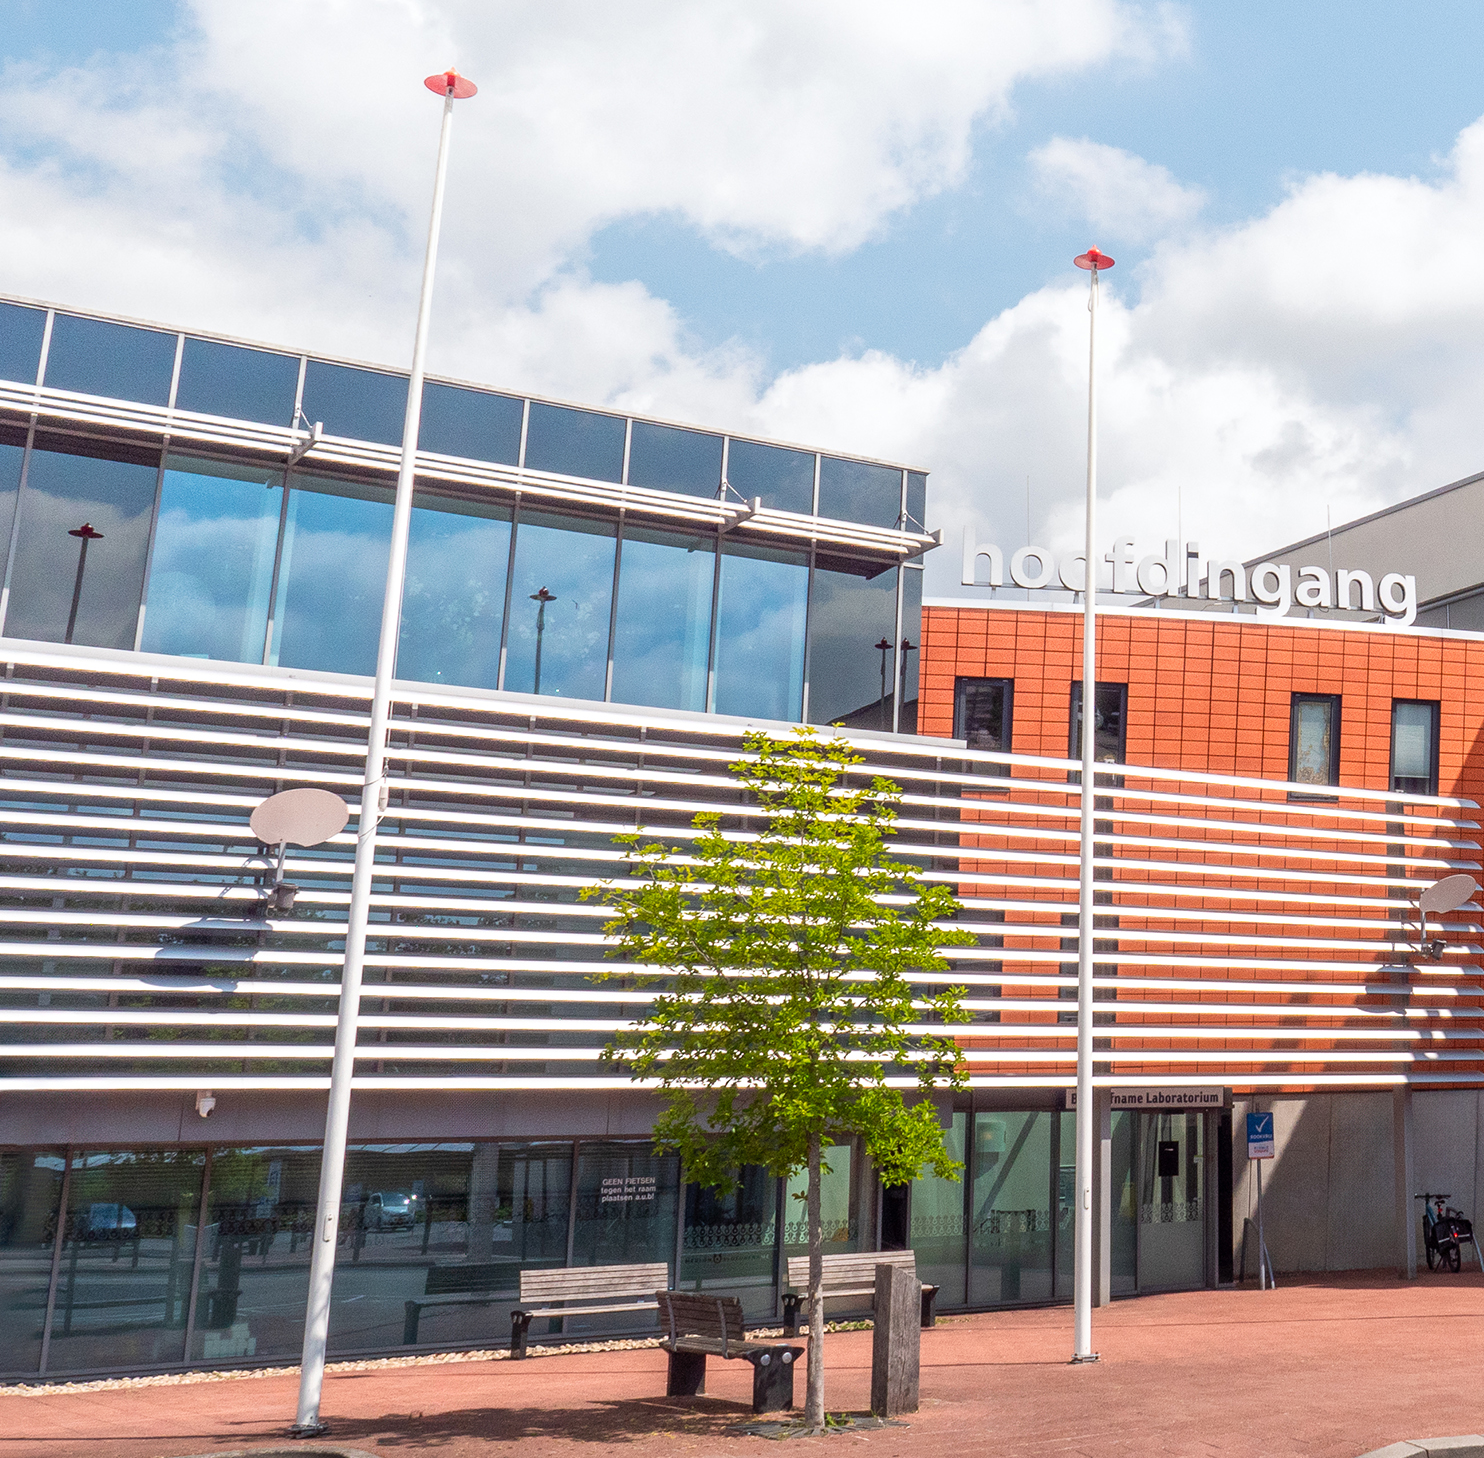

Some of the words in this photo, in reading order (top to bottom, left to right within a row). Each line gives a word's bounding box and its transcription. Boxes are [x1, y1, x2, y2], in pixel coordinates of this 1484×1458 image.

[962, 525, 1417, 627] hoofdingang
[1146, 1091, 1219, 1103] Laboratorium
[602, 1178, 623, 1186] GEEN
[624, 1177, 656, 1185] FIETSEN
[601, 1187, 622, 1195] tegen
[602, 1194, 633, 1203] plaatsen
